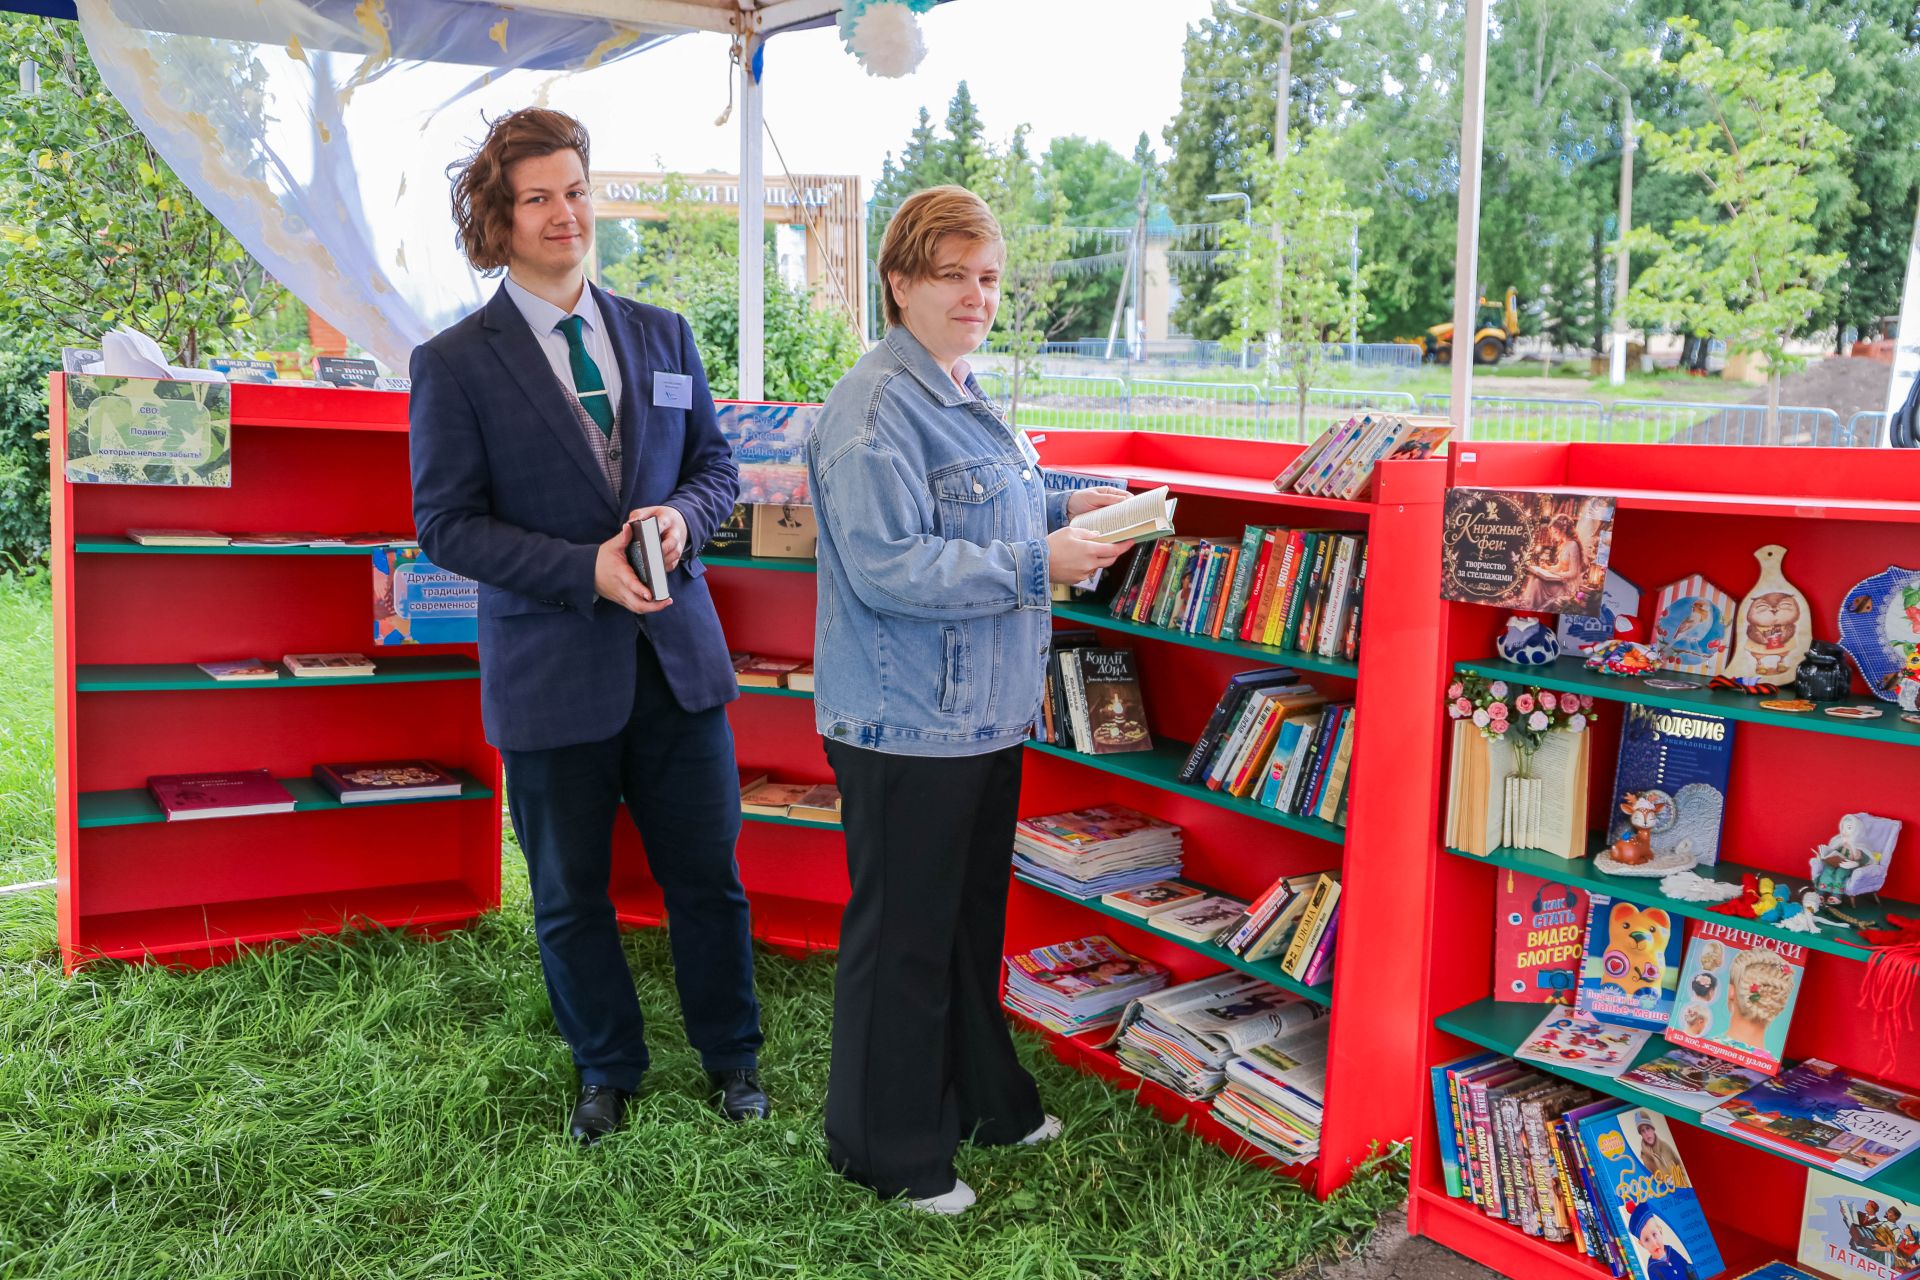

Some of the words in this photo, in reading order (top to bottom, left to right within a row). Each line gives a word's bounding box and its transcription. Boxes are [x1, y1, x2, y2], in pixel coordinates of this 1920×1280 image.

[139, 406, 160, 415] СВО:
[98, 449, 135, 457] которые
[1443, 512, 1524, 546] Книжные
[1477, 535, 1507, 560] феи:
[1276, 543, 1295, 588] ШИЛОВА
[1465, 560, 1507, 571] творчество
[1467, 571, 1513, 582] стеллажами
[422, 588, 470, 598] традиции
[1253, 579, 1261, 595] Один
[1284, 584, 1301, 629] Комнатные
[1295, 546, 1309, 583] Растения
[1086, 651, 1122, 664] КОНАН
[1098, 664, 1128, 676] ДОЙЛ
[1183, 738, 1209, 778] ПАНДОРА
[1542, 897, 1566, 911] КАК
[1533, 909, 1577, 929] СТАТЬ
[1527, 925, 1584, 948] ВИДЕО-
[1700, 920, 1802, 960] ПРИЧЕСКИ
[1517, 944, 1582, 969] БЛОГЕРО
[1591, 1000, 1670, 1022] папье-маше
[1673, 1033, 1685, 1042] из
[1685, 1036, 1701, 1049] кос,
[1701, 1041, 1738, 1060] жгутов
[1746, 1056, 1773, 1072] узлов
[1475, 1124, 1489, 1162] БУСЛАЕВ
[1481, 1162, 1494, 1208] МЕФОДИЙ
